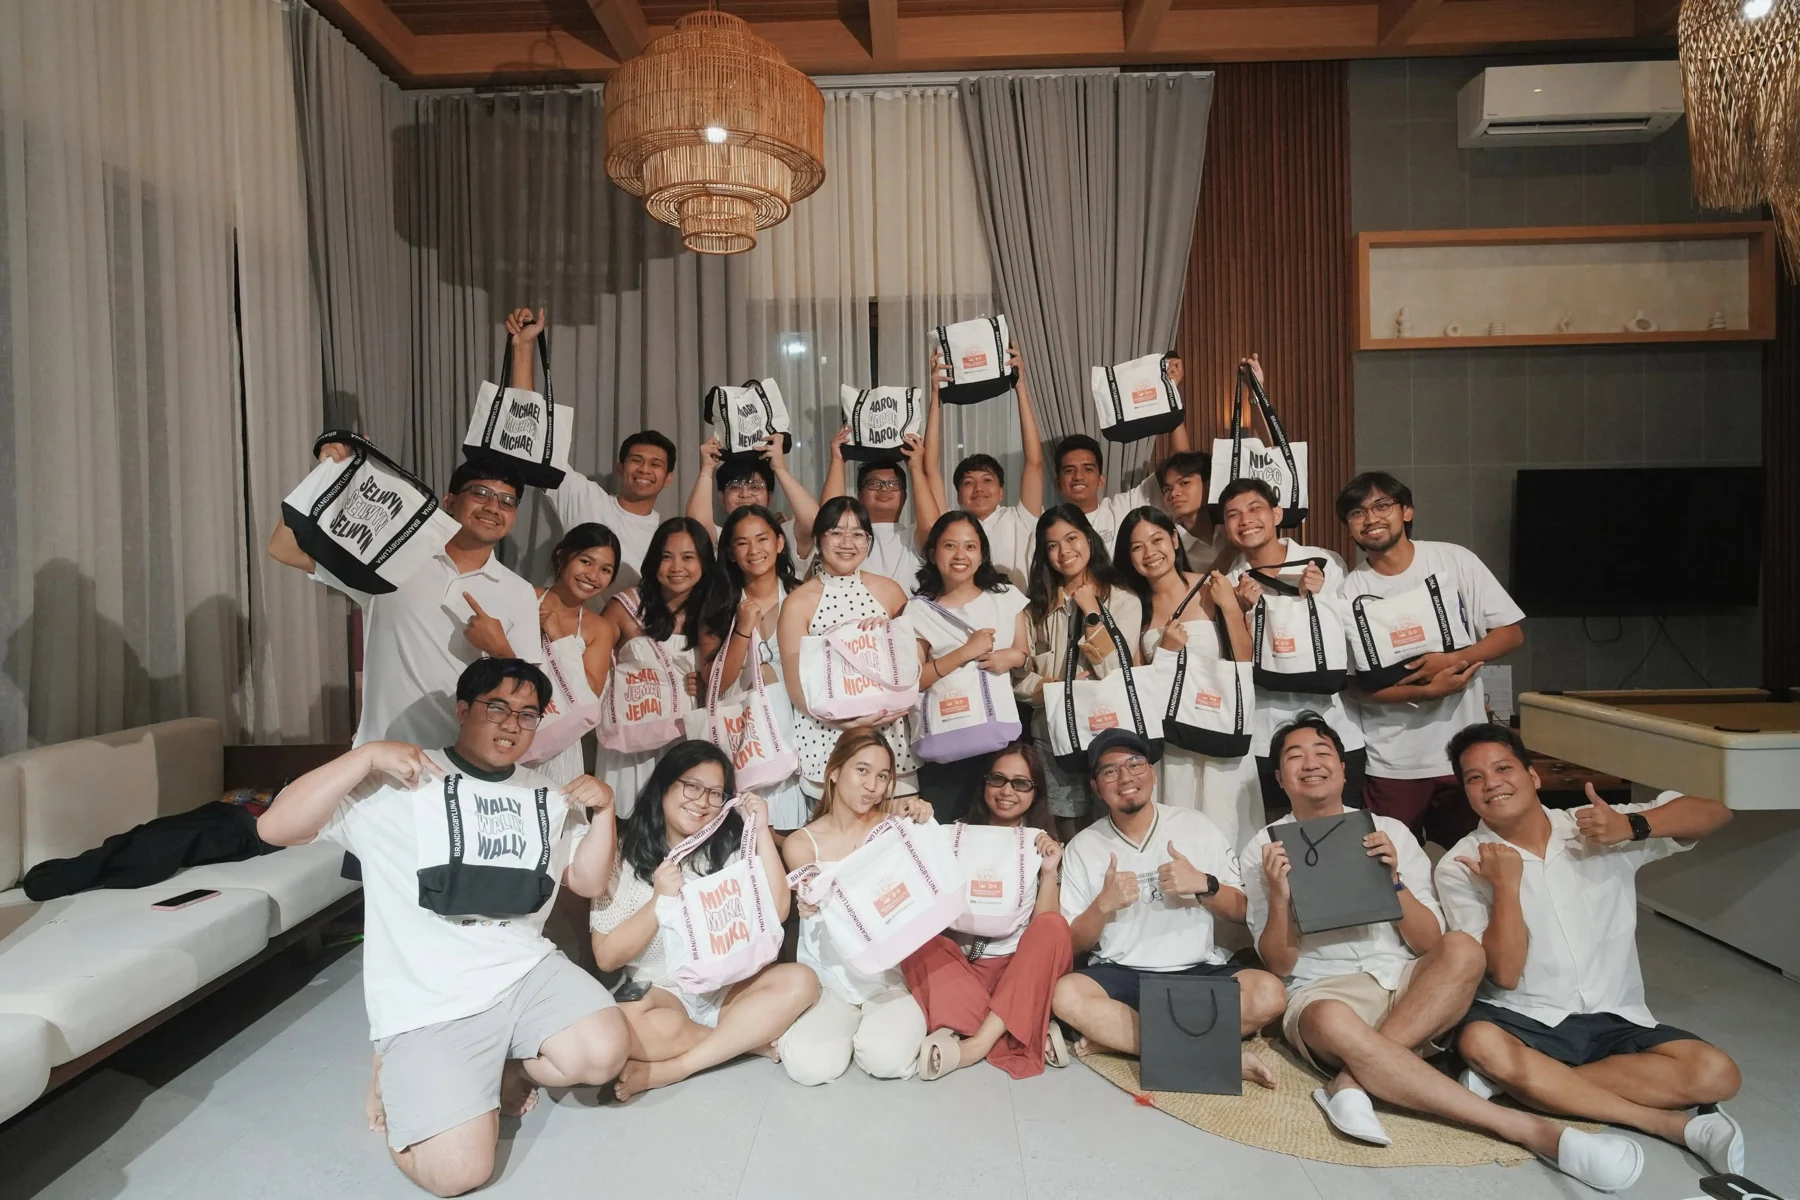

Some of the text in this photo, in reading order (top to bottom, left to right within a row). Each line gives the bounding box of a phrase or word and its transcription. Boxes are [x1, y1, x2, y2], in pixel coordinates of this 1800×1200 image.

[485, 400, 500, 443] BRANDINGBYLUNA
[504, 412, 537, 441] MICHAEL
[509, 398, 540, 424] MICHAEL
[868, 411, 898, 428] AARON
[870, 396, 898, 412] AARON
[500, 429, 534, 457] MICHAEL
[1270, 416, 1290, 456] BRANDINGBYLUNA
[312, 468, 354, 516] BRANDINGBYLUNA
[345, 489, 388, 536] SELWYN
[360, 475, 404, 520] SELWYN
[330, 509, 374, 555] SELWYN
[376, 518, 421, 564] BRANDINGBYLUNA
[1312, 616, 1324, 664] BRANDINGBYLUNA
[1358, 614, 1378, 666] BRANDINGBYLUNA
[1433, 596, 1452, 646] BRANDINGBYLUNA
[825, 650, 834, 698] BRANDINGBYLUNA
[888, 638, 899, 685] BRANDINGBYLUN
[1114, 634, 1132, 682] BRANDINGBYLUNA
[550, 660, 574, 704] BRANDINGBYLUNA
[624, 682, 662, 702] JEMAI
[668, 672, 678, 712] BRANDINGBYLUNA
[711, 667, 720, 716] BRANDINGBYLUNA
[980, 672, 994, 717] BRANDINGBYLUNA
[1169, 670, 1182, 716] BRANDINGBYLUNA
[626, 698, 662, 721] JEMAI
[763, 705, 780, 752] BRANDINGBYLUNA
[1066, 699, 1078, 748] BRANDINGBYLUNA
[1128, 686, 1144, 734] BRANDINGBYLUNA
[732, 741, 766, 770] KAYE
[450, 799, 460, 856] BRANDINGBYLUNA
[474, 793, 522, 816] WALLY
[475, 812, 525, 836] WALLY
[478, 832, 526, 860] WALLY
[539, 809, 550, 865] BRANDINGBYLUNA
[905, 841, 938, 895] BRANDINGBYLUNA
[698, 878, 741, 910] MIKA
[704, 898, 746, 932] MIKA
[751, 875, 764, 932] BRANDINGBYLUNA
[836, 888, 872, 942] BRANDINGBYLUNA
[683, 905, 699, 960] BRANDINGBYLUNA
[709, 920, 750, 956] MIKA
